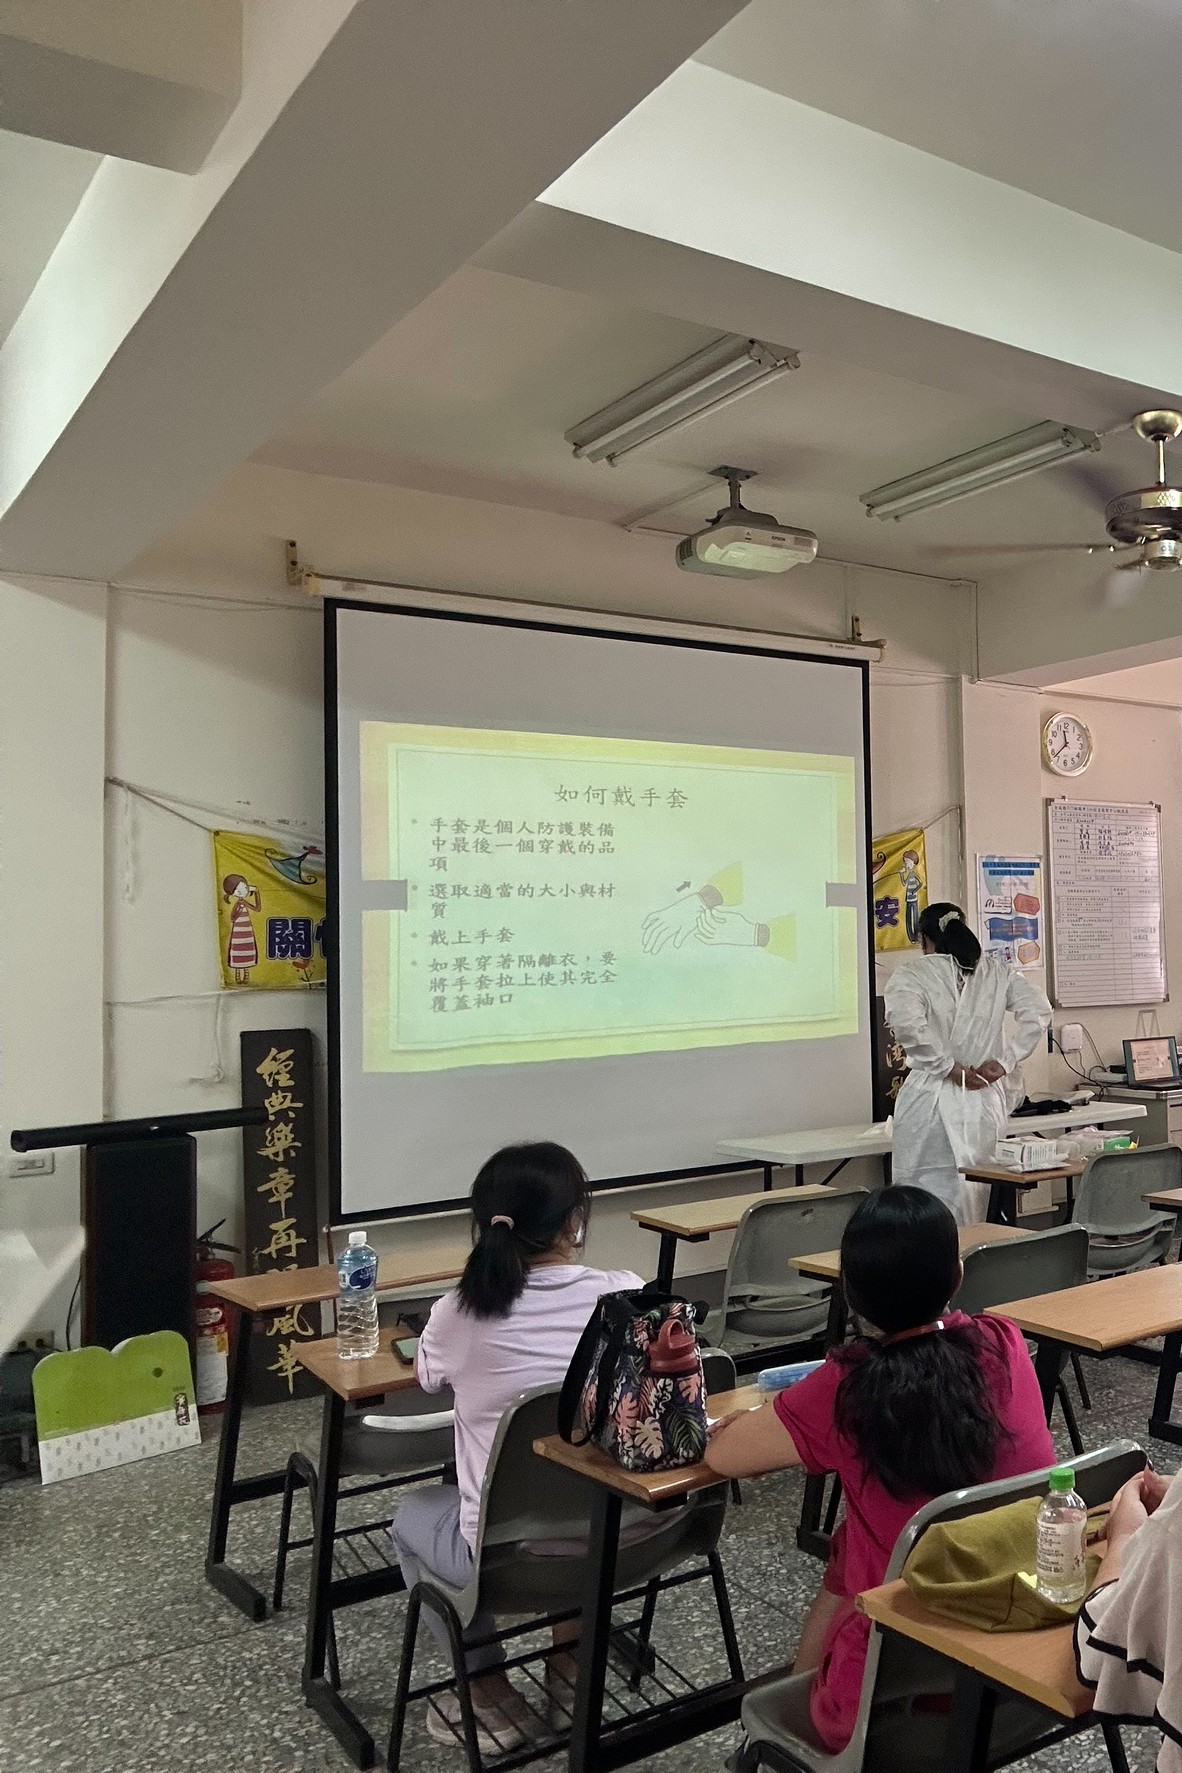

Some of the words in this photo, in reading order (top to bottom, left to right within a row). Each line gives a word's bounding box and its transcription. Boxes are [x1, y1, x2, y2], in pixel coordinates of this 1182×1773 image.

[554, 784, 689, 809] 如何戴手套
[430, 817, 616, 837] 手套是個人防護裝備
[431, 836, 616, 855] 中最後一個穿戴的品
[429, 856, 448, 872] 項
[430, 882, 616, 900] 選取適當的大小與材
[431, 902, 448, 920] 質
[267, 918, 326, 960] 關
[429, 926, 515, 946] 戴上手套
[428, 970, 618, 993] 將手套拉上使其完全
[430, 993, 513, 1012] 覆蓋袖口
[255, 1047, 315, 1394] 經典樂章再風華
